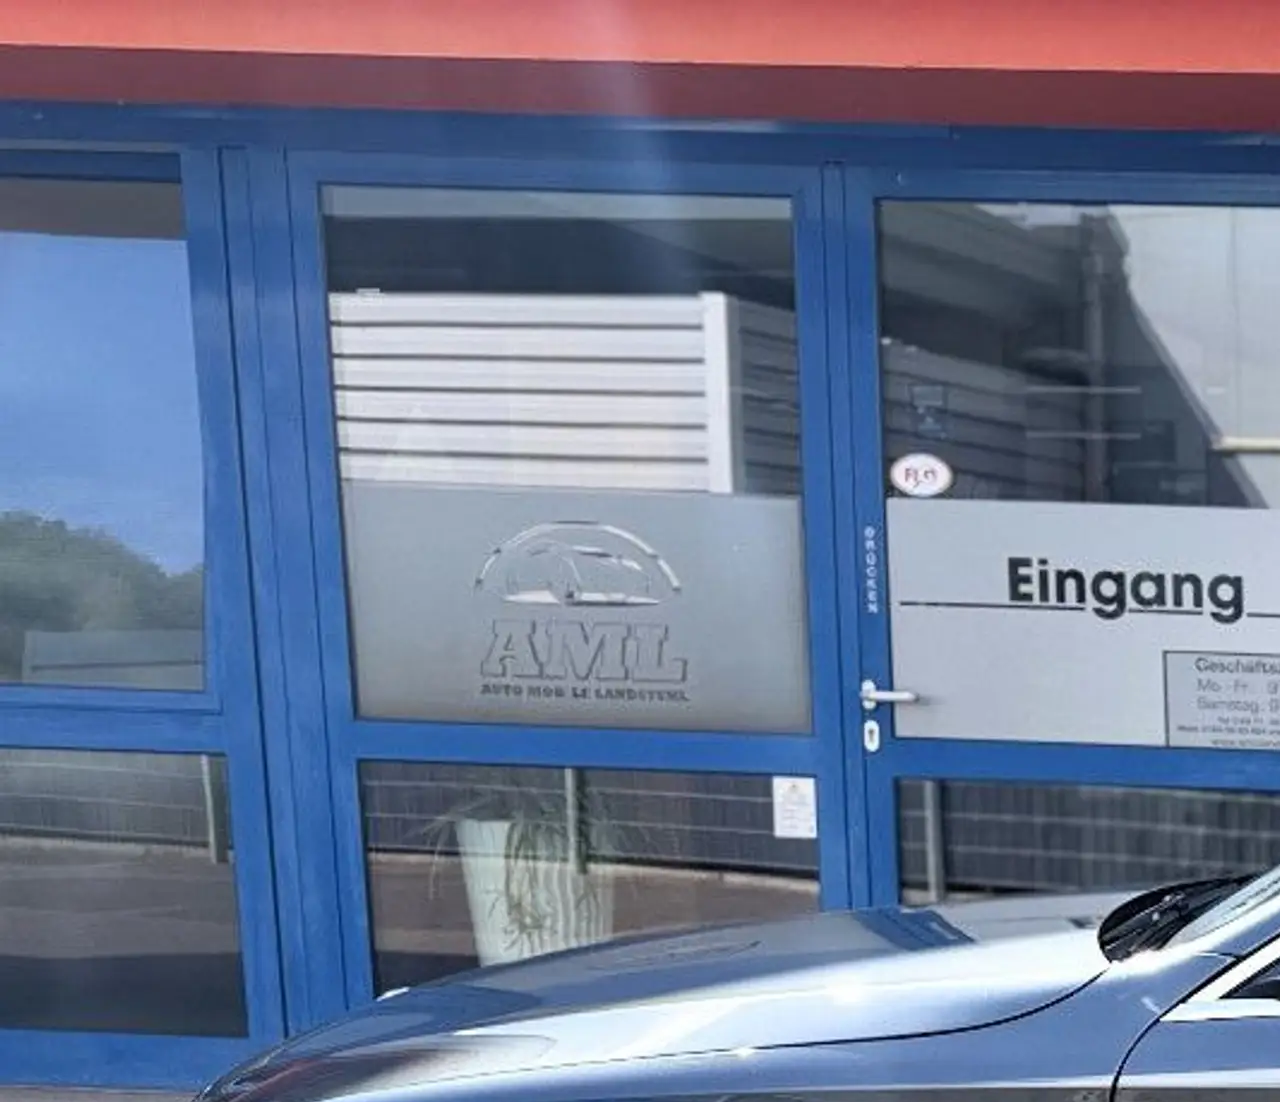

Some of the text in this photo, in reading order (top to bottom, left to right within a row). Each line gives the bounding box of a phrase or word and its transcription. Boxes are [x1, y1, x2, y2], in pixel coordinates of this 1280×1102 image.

[1007, 557, 1242, 624] Eingang
[481, 619, 687, 682] AML
[480, 683, 523, 698] AUTO
[527, 685, 591, 699] MOBLE
